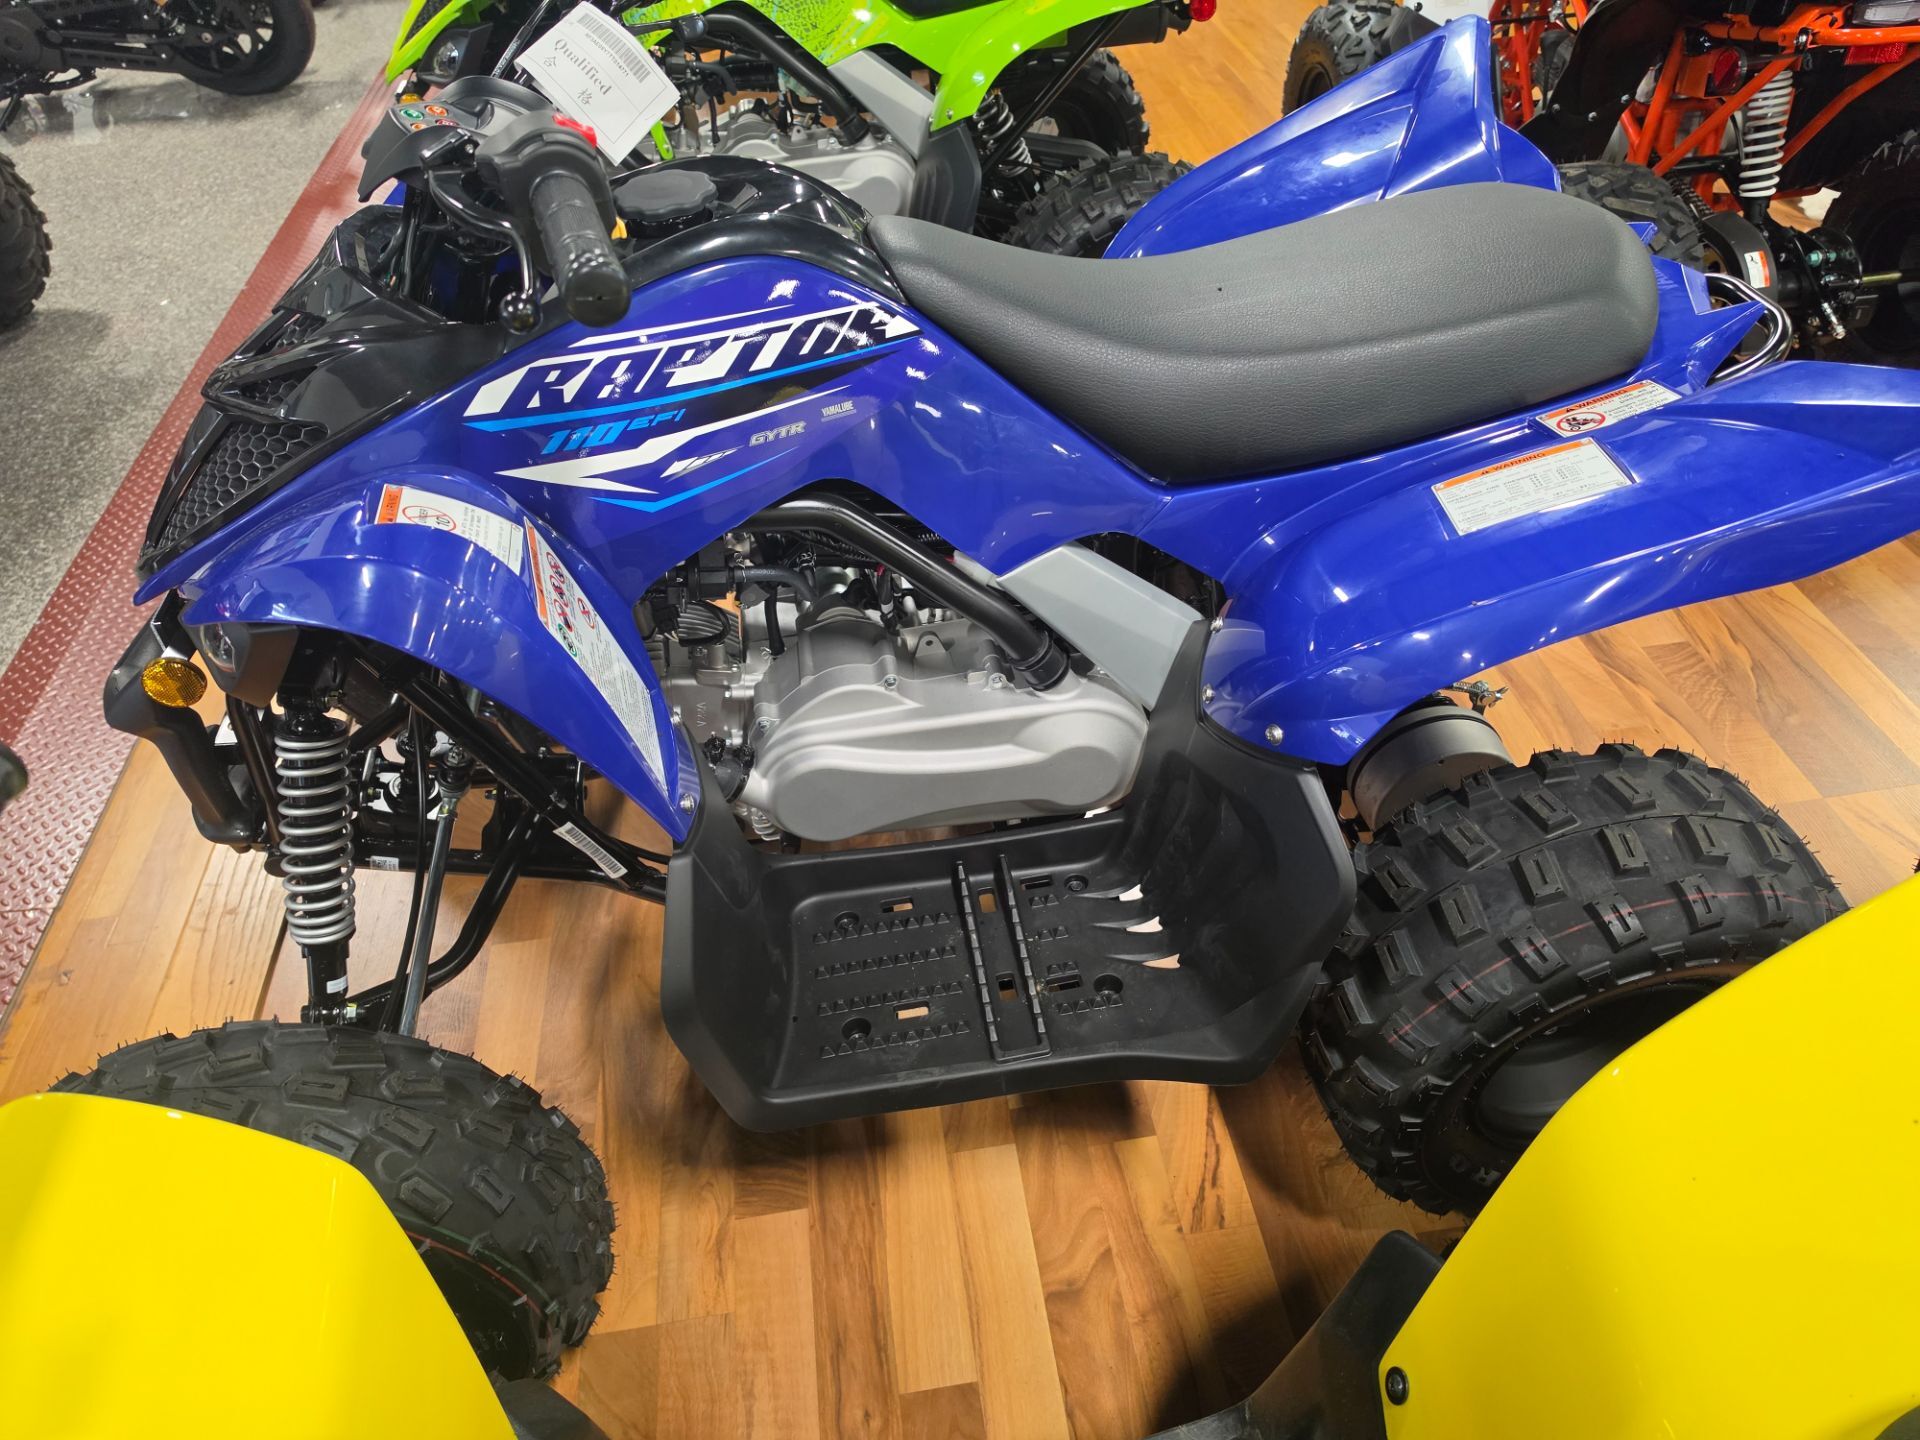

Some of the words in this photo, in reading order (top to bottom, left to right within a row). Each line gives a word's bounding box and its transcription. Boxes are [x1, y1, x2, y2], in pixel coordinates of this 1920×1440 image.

[543, 55, 557, 68] 合
[577, 88, 593, 105] 格
[554, 38, 612, 96] Qualified
[494, 303, 914, 414] RAPTOR
[822, 402, 855, 417] YAMALUBE
[540, 420, 630, 454] 110
[627, 408, 686, 431] EFI
[750, 420, 807, 447] GYTR
[1494, 453, 1545, 472] WARNING
[435, 516, 451, 527] 10
